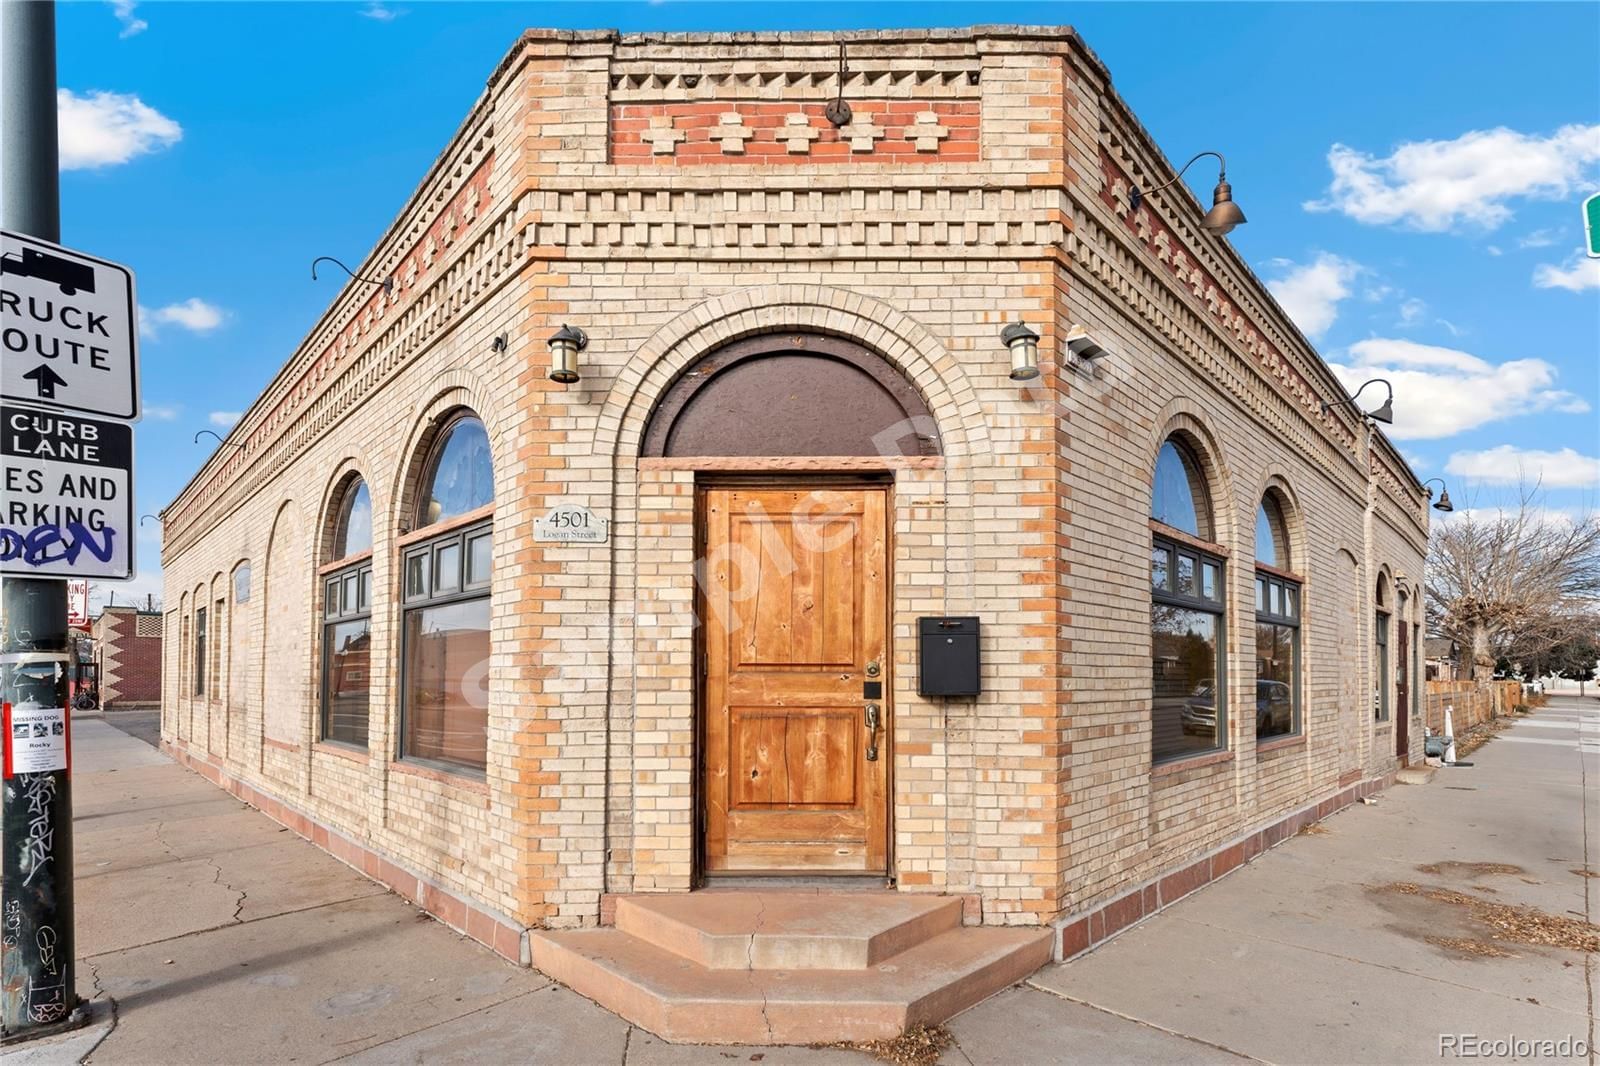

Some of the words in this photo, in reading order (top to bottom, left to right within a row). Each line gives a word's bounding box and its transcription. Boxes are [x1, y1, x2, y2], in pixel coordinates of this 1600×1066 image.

[10, 414, 99, 441] CURB
[13, 435, 100, 462] LANE
[58, 473, 117, 501] AND
[549, 511, 589, 528] 4501
[543, 530, 570, 539] Logan
[571, 529, 597, 539] Street
